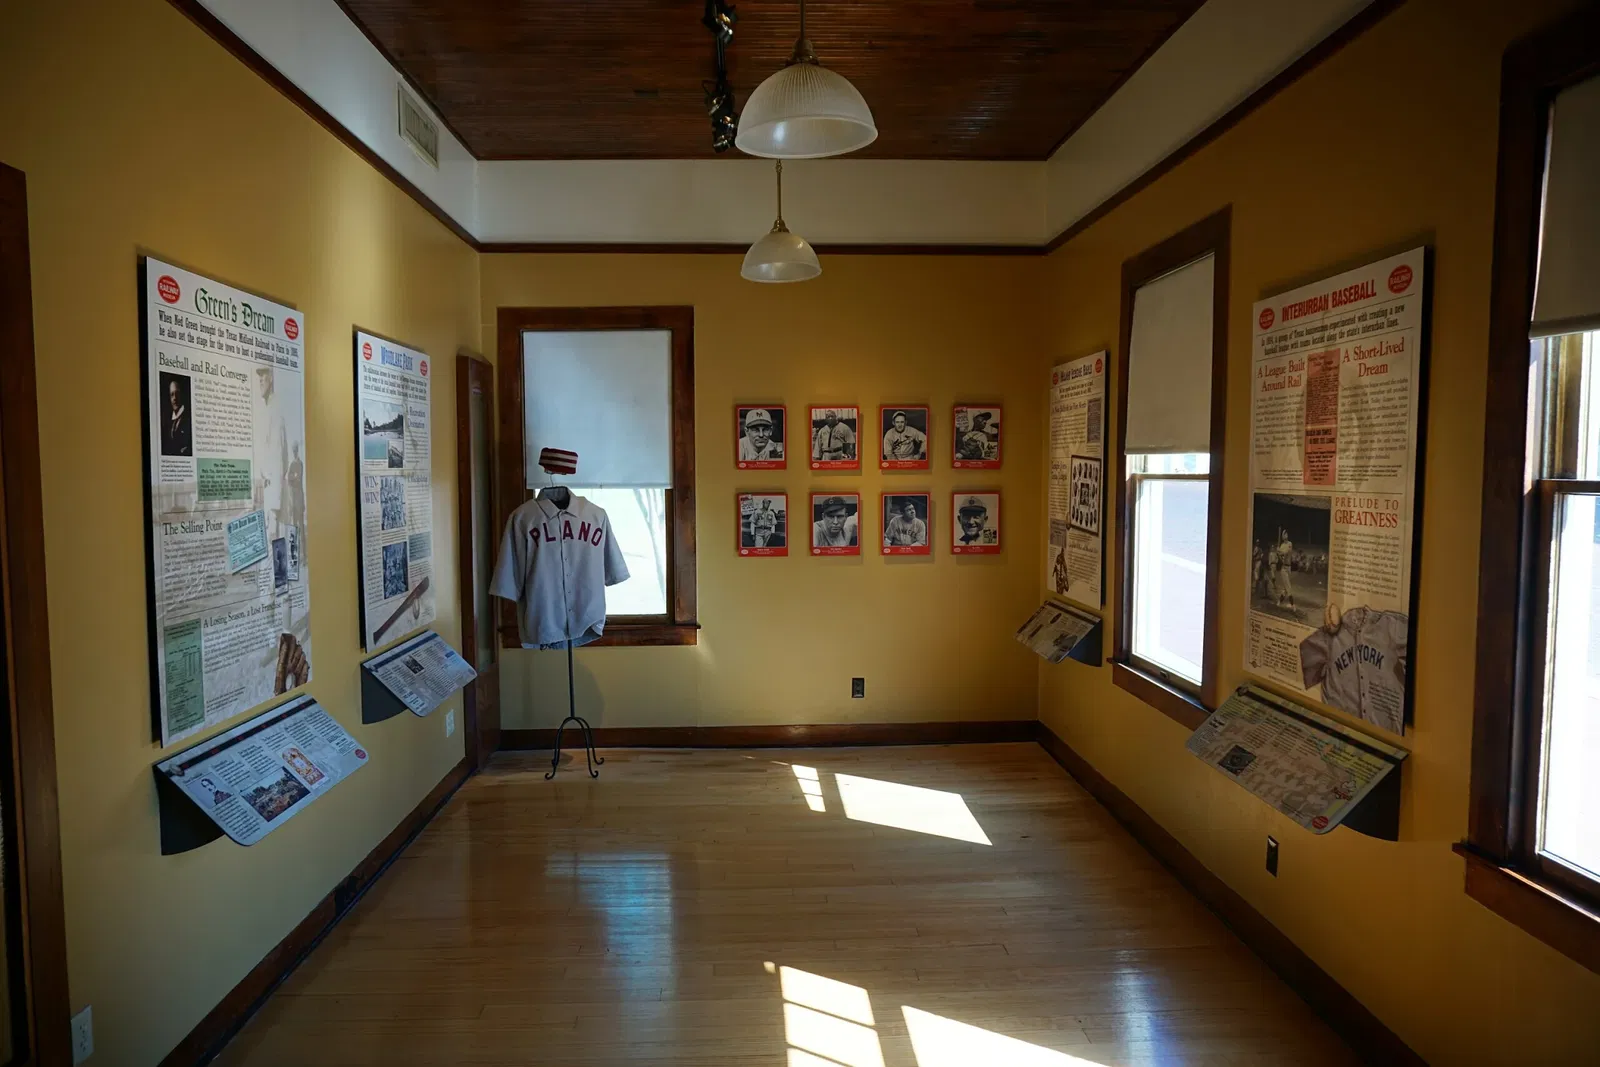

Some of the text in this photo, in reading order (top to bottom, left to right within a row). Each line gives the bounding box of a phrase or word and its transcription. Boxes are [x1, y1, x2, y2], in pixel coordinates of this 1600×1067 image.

[194, 288, 274, 334] Green's Dream
[1282, 279, 1376, 322] INTERURBAN BASEBALL
[1394, 304, 1405, 314] new
[159, 310, 172, 324] When
[174, 314, 183, 327] Ned
[186, 318, 198, 330] Green
[226, 329, 237, 341] Texas
[159, 324, 165, 336] he
[168, 326, 176, 339] also
[1342, 337, 1404, 364] A Short-Lived
[159, 352, 248, 383] Baseball and Rail Converge
[1257, 358, 1305, 378] A League Built
[1359, 363, 1388, 377] Dream
[1260, 374, 1301, 392] Around Rail
[1335, 497, 1399, 510] PRELUDE TO
[162, 519, 223, 535] The Selling Point
[1335, 509, 1398, 528] GREATNESS
[529, 520, 603, 548] PLANO
[204, 618, 208, 628] A
[210, 616, 227, 627] Losing
[251, 606, 261, 615] Lost
[1334, 644, 1384, 674] NEW YORK
